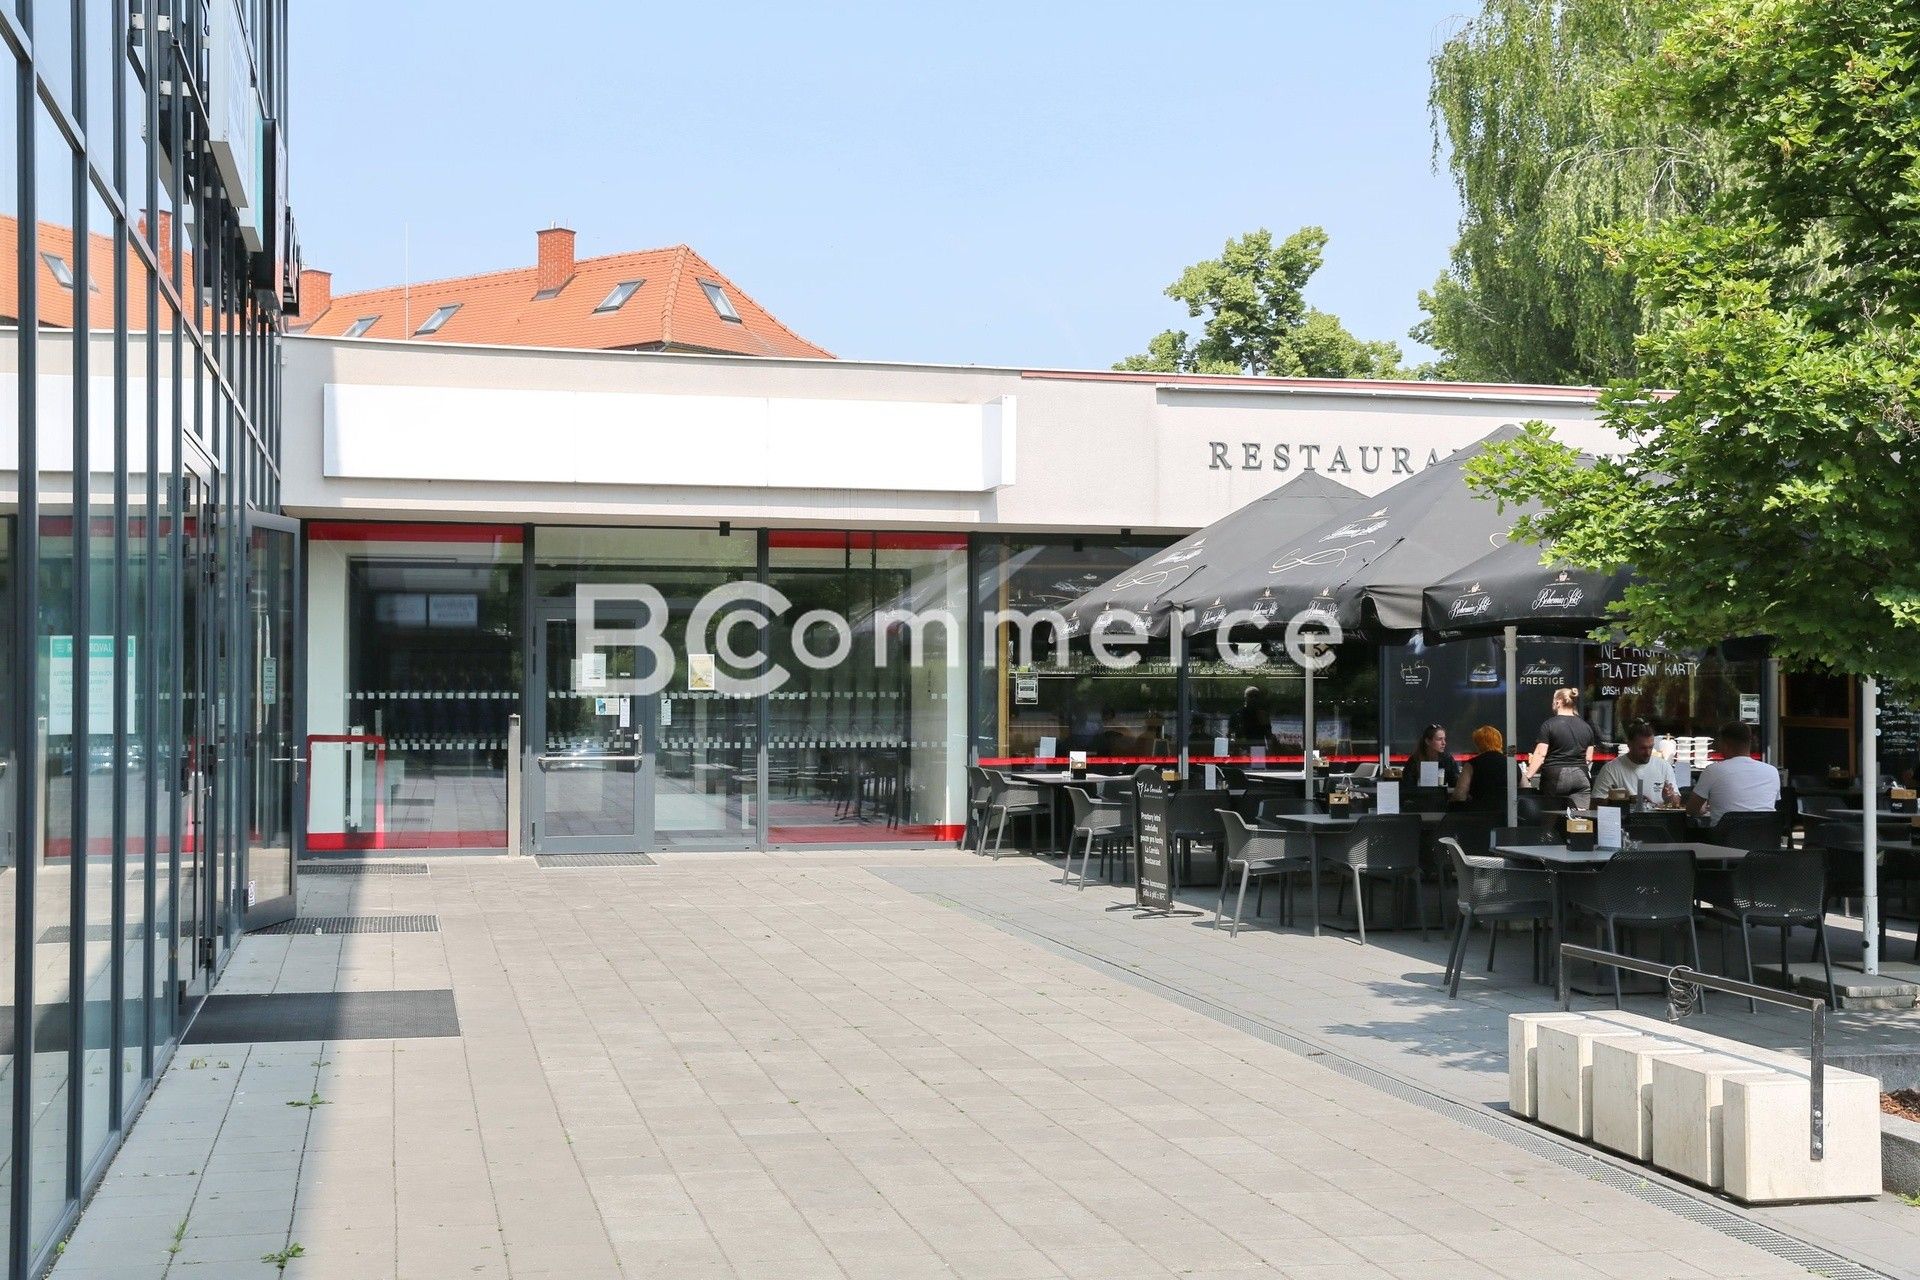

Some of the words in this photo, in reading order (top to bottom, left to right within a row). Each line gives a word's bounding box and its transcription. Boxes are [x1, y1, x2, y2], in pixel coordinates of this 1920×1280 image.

[1208, 441, 1462, 475] RESTAURA
[1665, 662, 1700, 677] KARTY
[1520, 676, 1565, 685] PRESTIGE
[1601, 686, 1620, 696] CASH
[1623, 686, 1643, 696] ONLY
